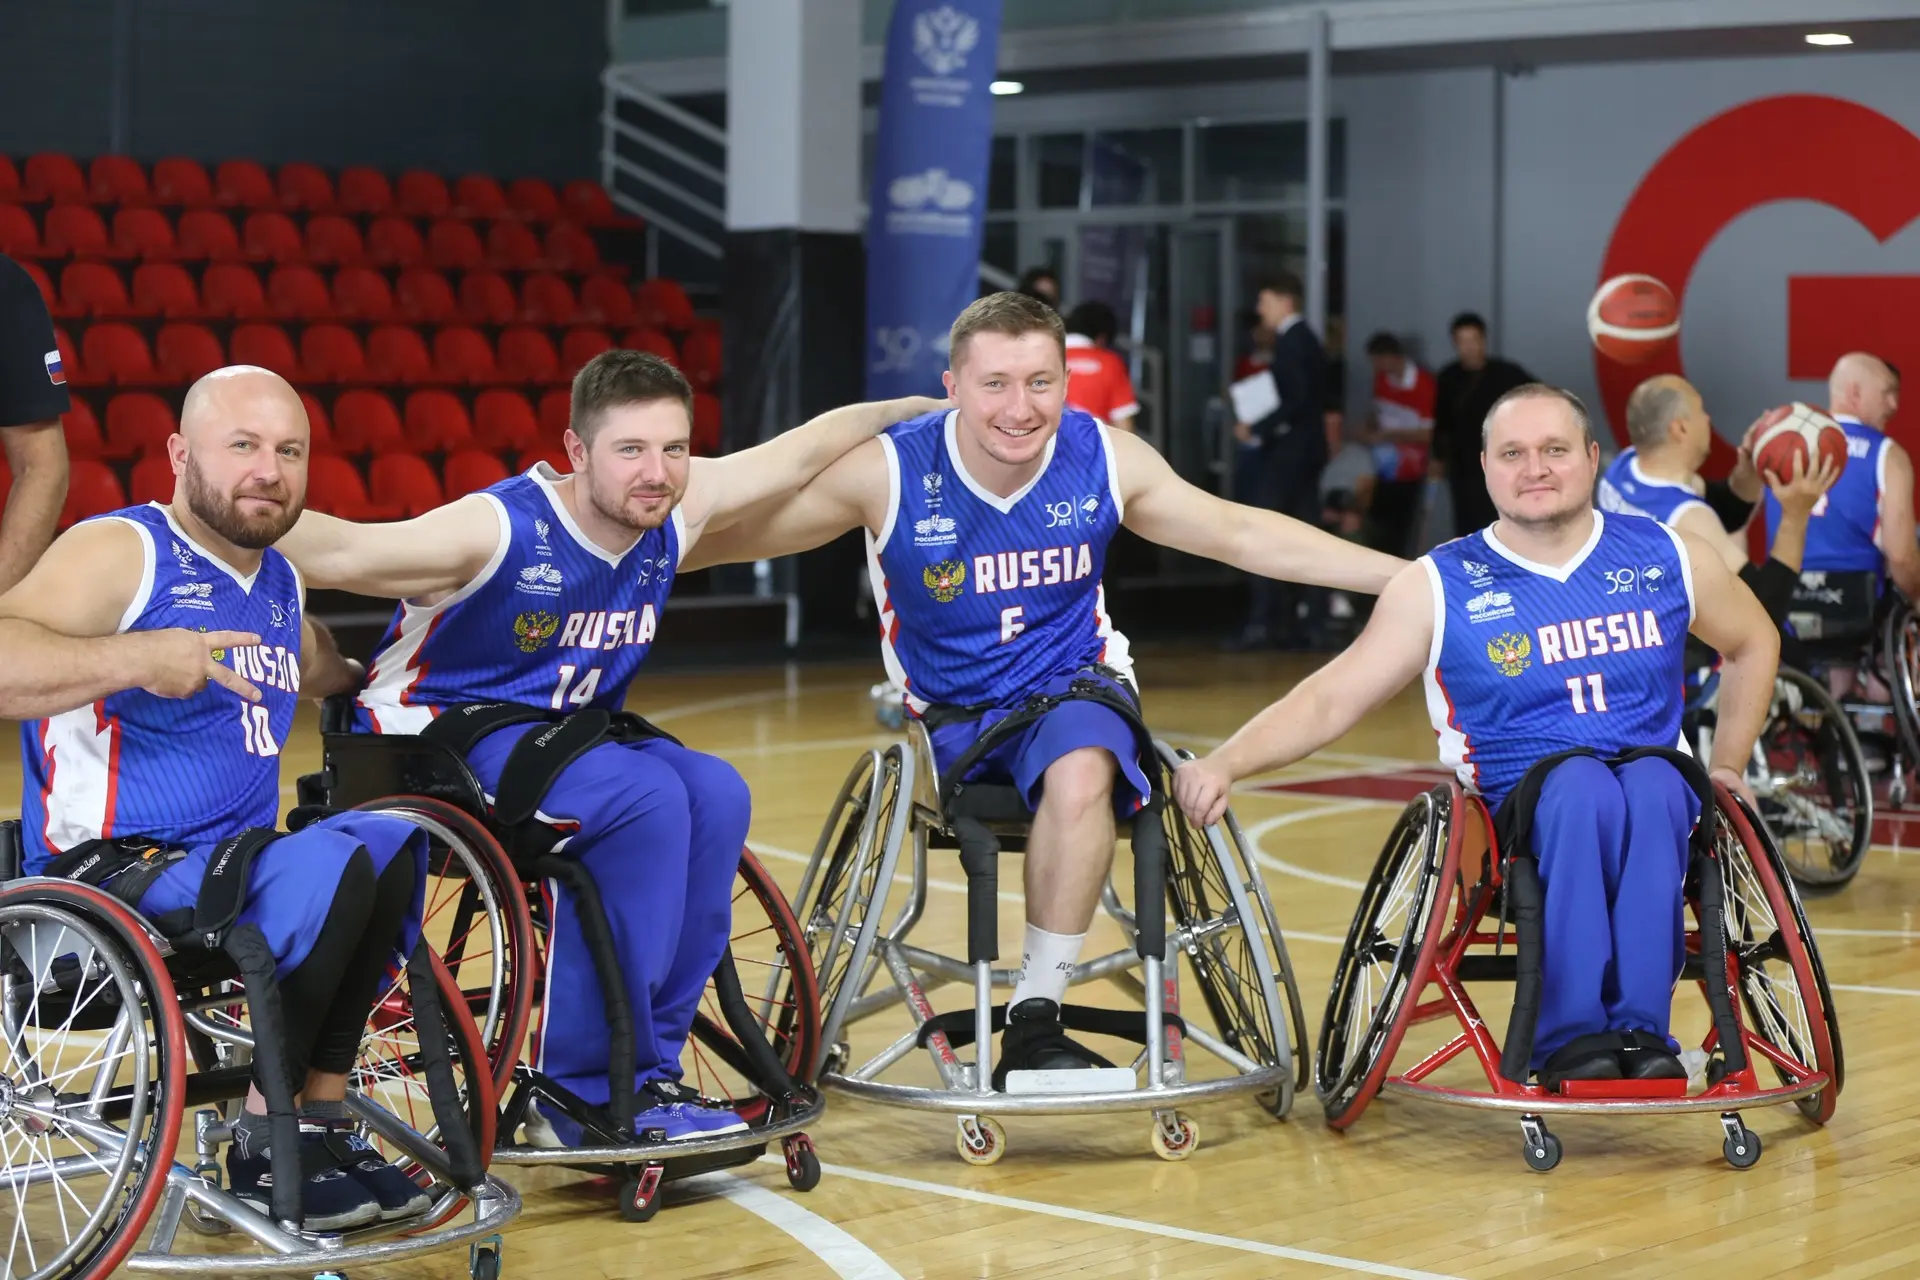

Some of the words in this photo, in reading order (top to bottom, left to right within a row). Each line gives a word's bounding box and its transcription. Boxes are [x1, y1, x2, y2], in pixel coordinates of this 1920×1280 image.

[1044, 501, 1072, 528] 30
[1058, 518, 1072, 526] ЛЕТ
[974, 543, 1092, 594] RUSSIA
[1603, 568, 1635, 595] 30
[1619, 584, 1634, 593] ЛЕТ
[1001, 606, 1025, 645] 6
[1537, 610, 1664, 665] RUSSIA
[551, 664, 602, 710] 14
[1566, 673, 1608, 714] 11
[240, 700, 280, 757] 10
